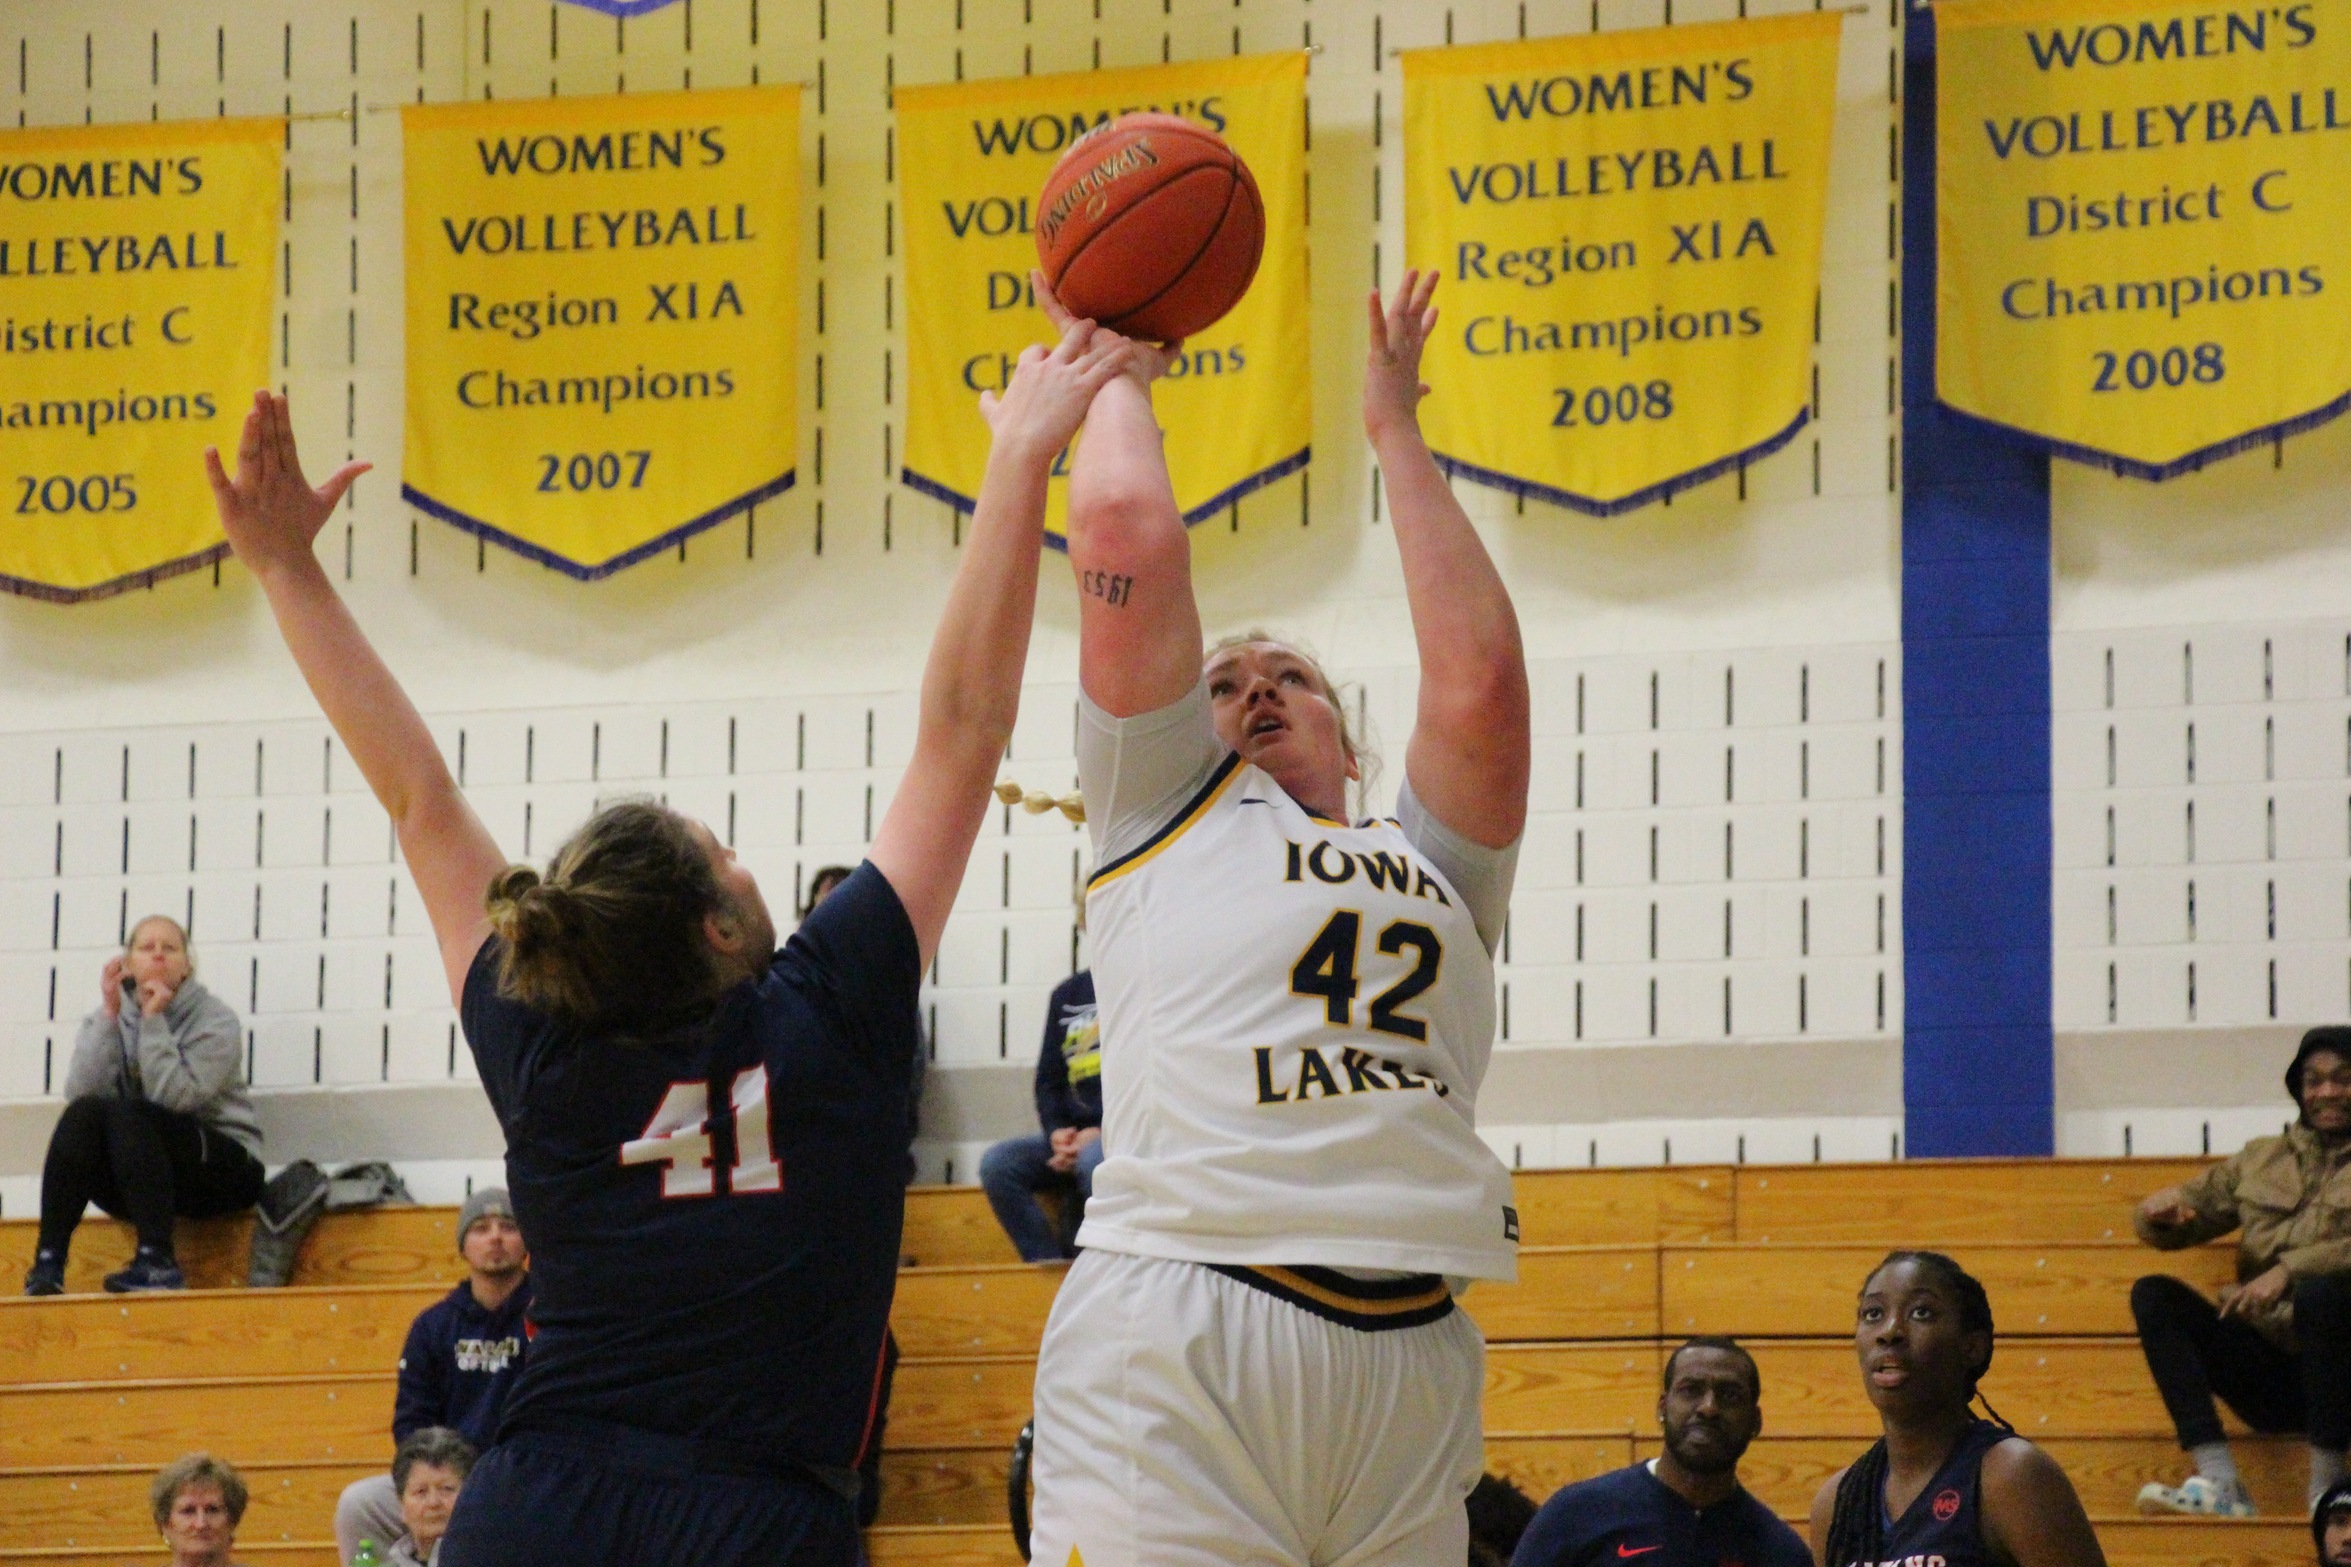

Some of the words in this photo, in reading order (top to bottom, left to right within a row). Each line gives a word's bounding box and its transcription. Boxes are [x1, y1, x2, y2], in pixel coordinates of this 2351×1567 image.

[2026, 4, 2316, 72] WOMEN'S
[1485, 59, 1754, 122] WOMEN'S
[1983, 87, 2351, 159] VOLLEYBALL
[477, 127, 726, 177] WOMEN'S
[1449, 139, 1789, 204] VOLLEYBALL
[0, 158, 203, 201] OMEN'S
[2026, 183, 2224, 238] District
[2251, 170, 2294, 212] C
[442, 203, 756, 256] VOLLEYBALL
[1457, 237, 1637, 287] Region
[449, 292, 618, 339] Region
[2000, 265, 2324, 320] Champions
[160, 306, 194, 344] C
[1464, 305, 1763, 358] Champions
[456, 365, 734, 413] Champions
[2092, 342, 2226, 392] 2008
[1551, 380, 1675, 427] 2008
[15, 474, 138, 514] 2005
[536, 451, 651, 493] 2007
[1283, 838, 1453, 908] IOWA
[1288, 908, 1444, 1043] 42
[619, 1060, 783, 1199] 41
